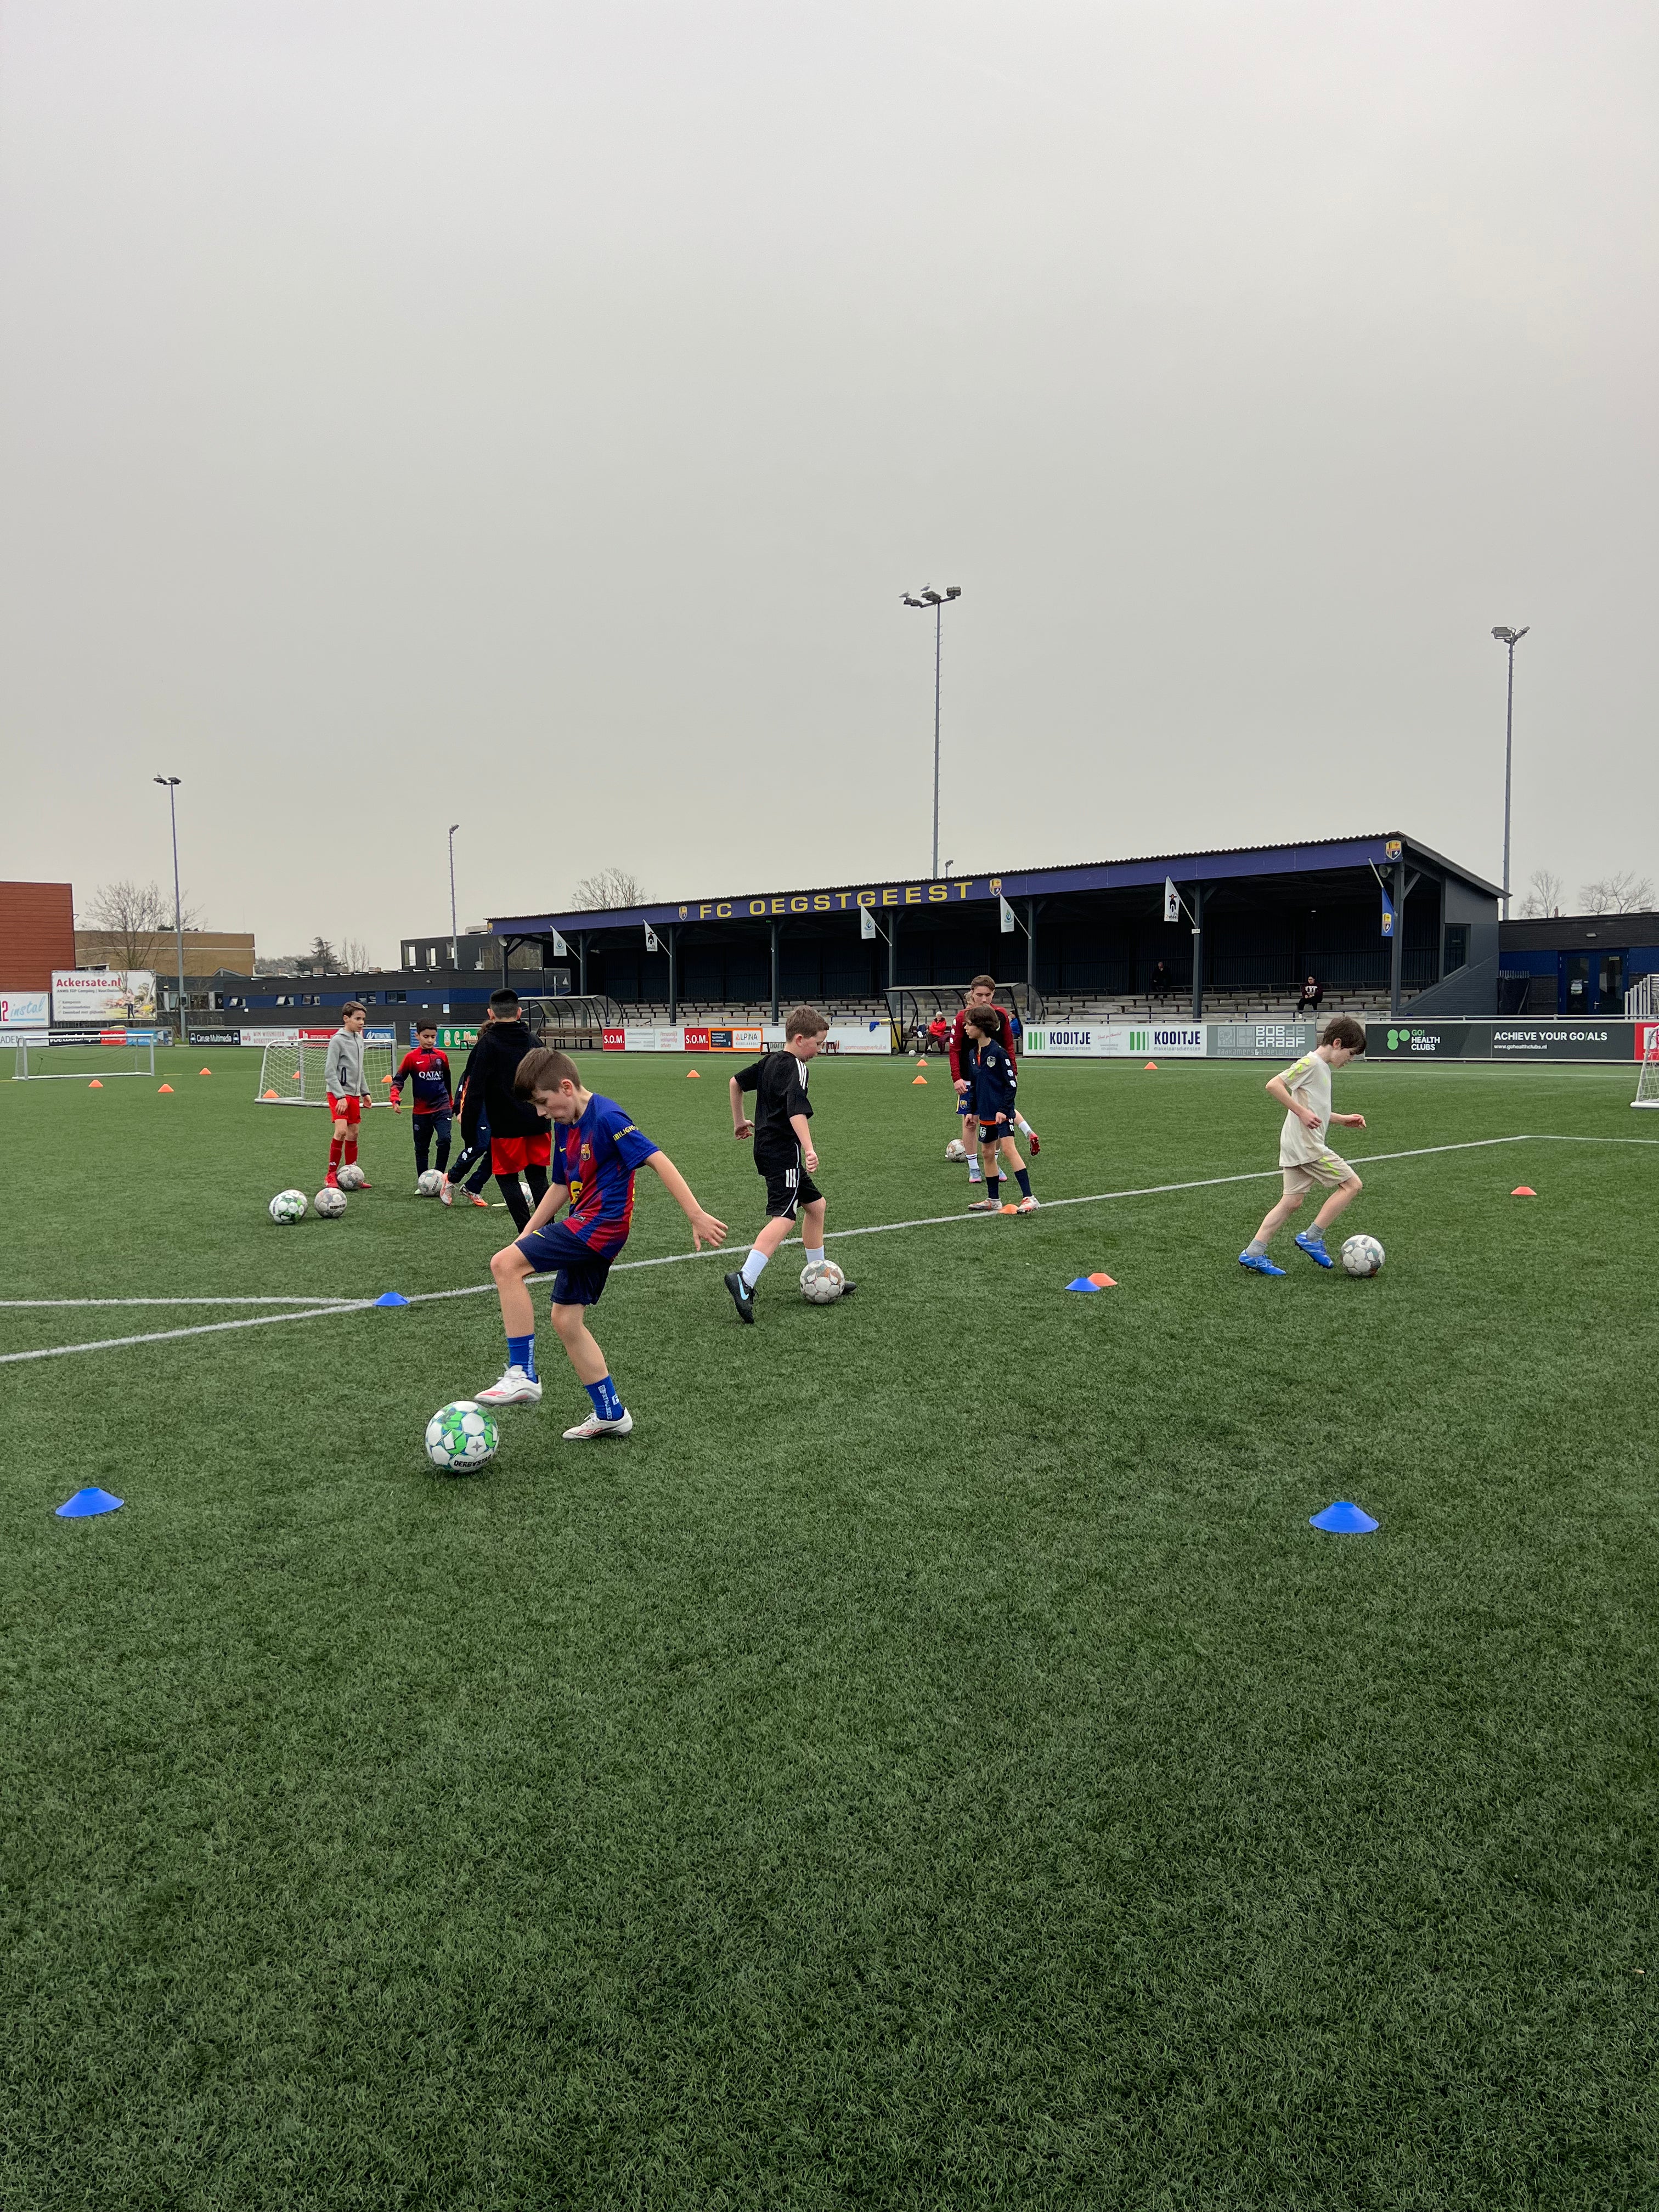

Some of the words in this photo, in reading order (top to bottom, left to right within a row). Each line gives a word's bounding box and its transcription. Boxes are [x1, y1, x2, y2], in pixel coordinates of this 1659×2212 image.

[699, 904, 732, 919] FC
[749, 882, 973, 916] OEGSTGEEST
[57, 978, 121, 987] Ackersate.nl
[10, 996, 46, 1017] instal
[604, 1035, 625, 1044] S.O.M.
[686, 1035, 708, 1044] S.O.M.
[1050, 1032, 1091, 1045] KOOITJE
[1154, 1031, 1200, 1045] KOOITJE
[1494, 1032, 1537, 1041] ACHIEVE
[1539, 1032, 1567, 1041] YOUR
[453, 1454, 492, 1468] DERBYSTAR
